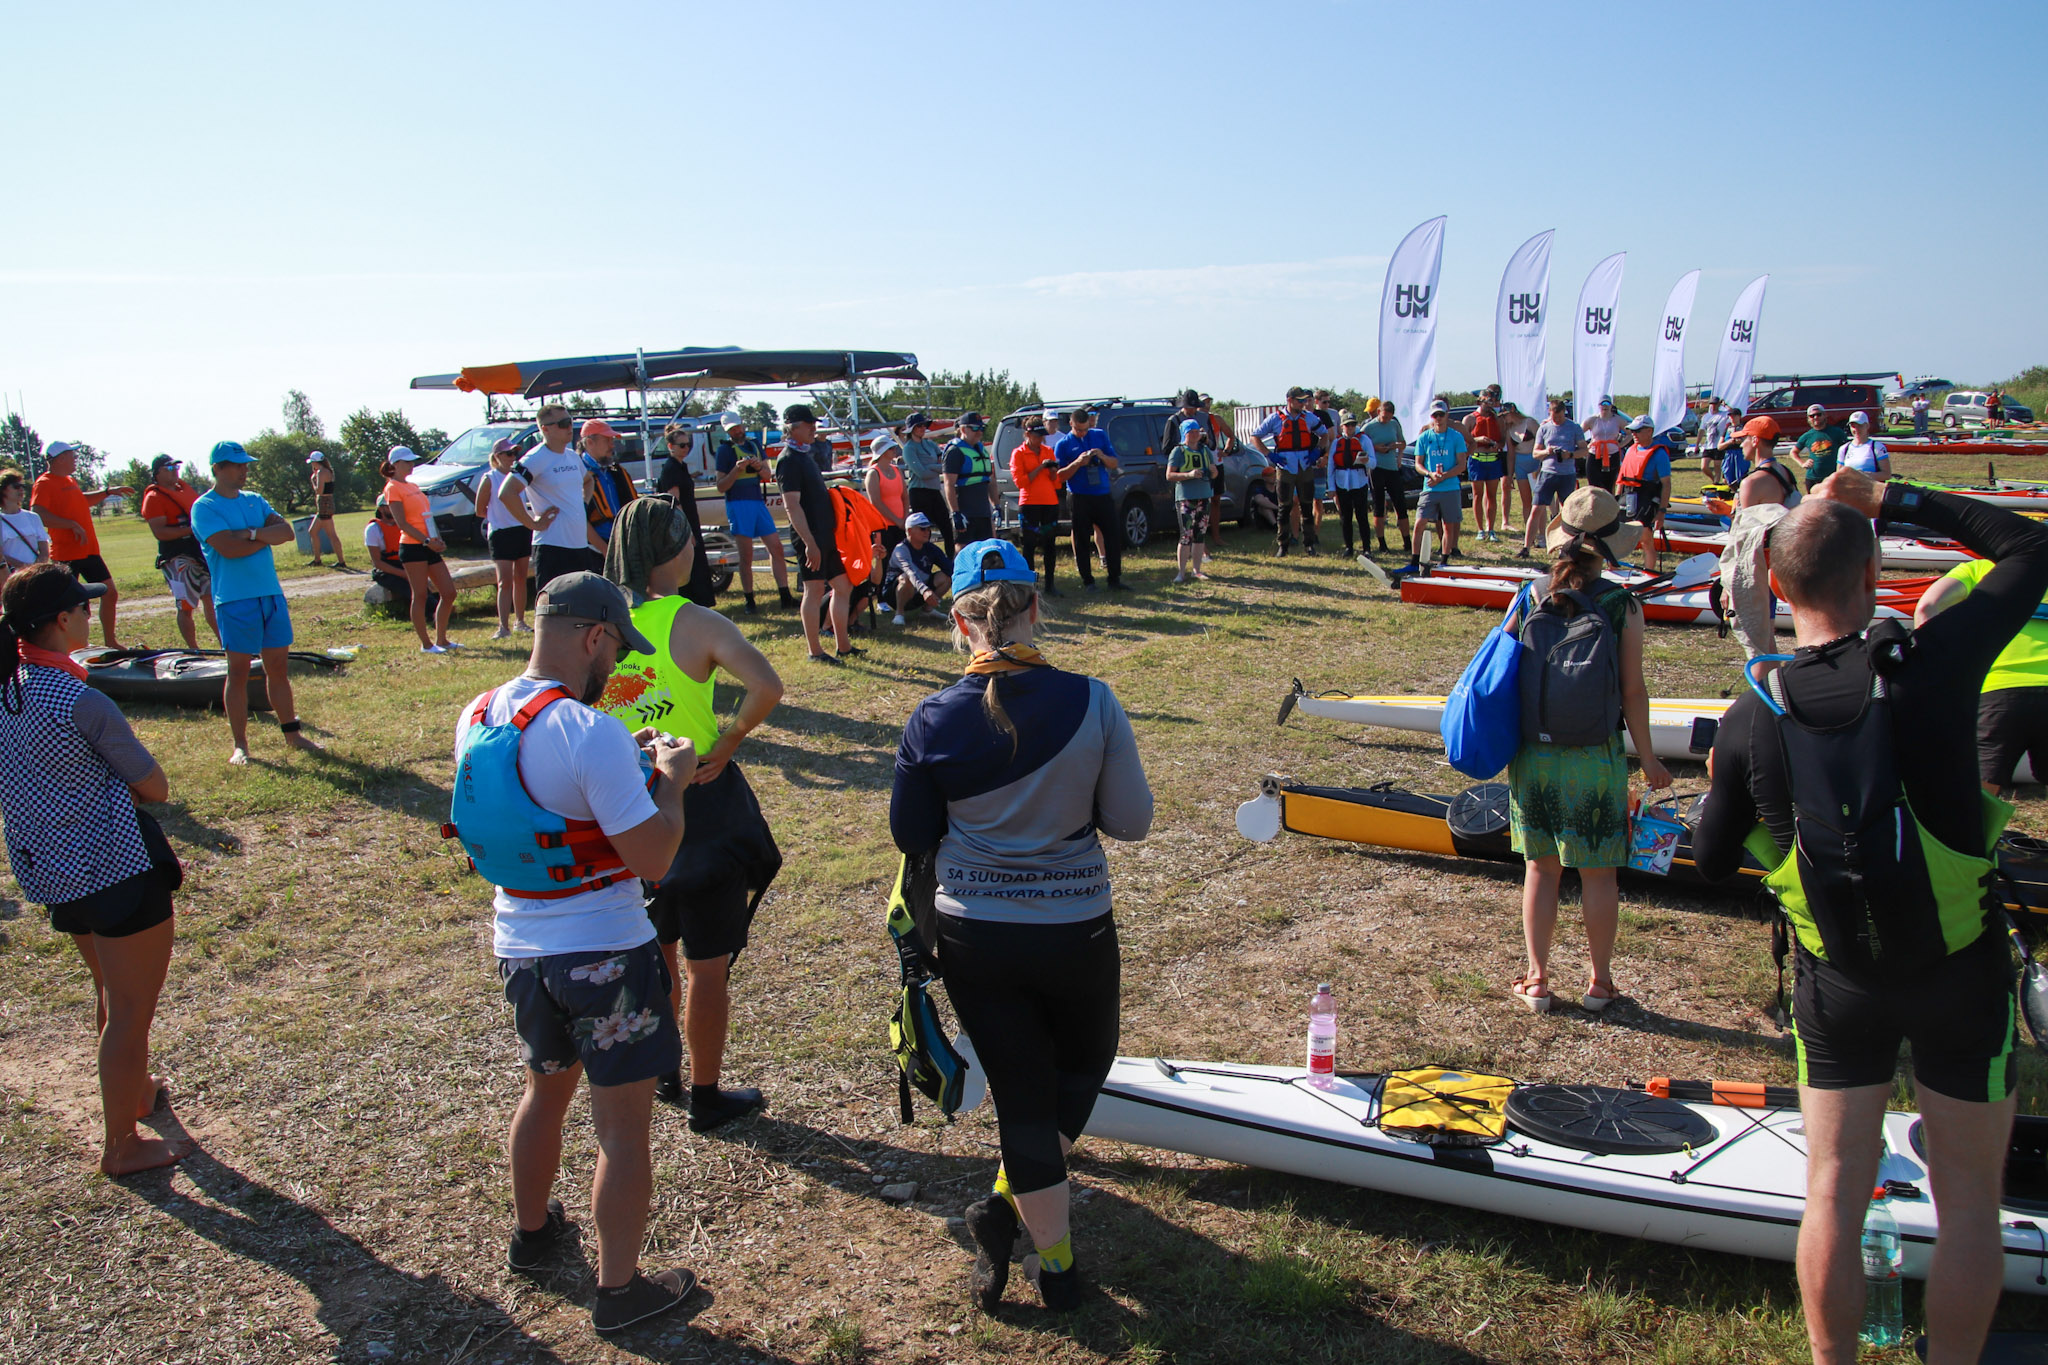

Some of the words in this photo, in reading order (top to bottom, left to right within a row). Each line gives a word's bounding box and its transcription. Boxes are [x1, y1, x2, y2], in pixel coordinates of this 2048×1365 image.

[1396, 284, 1430, 303] HU
[1509, 293, 1540, 310] HU
[1395, 301, 1429, 318] UM
[1509, 308, 1539, 324] UM
[1586, 307, 1612, 322] HU
[1585, 320, 1611, 335] UM
[1666, 316, 1684, 330] HU
[1732, 319, 1753, 332] HU
[1665, 328, 1681, 341] UM
[1730, 331, 1752, 343] UM
[1431, 449, 1449, 457] RUN
[621, 662, 641, 671] jooks
[947, 868, 964, 881] SA
[968, 870, 1037, 883] SUUDAD
[1042, 863, 1103, 881] ROHKEM
